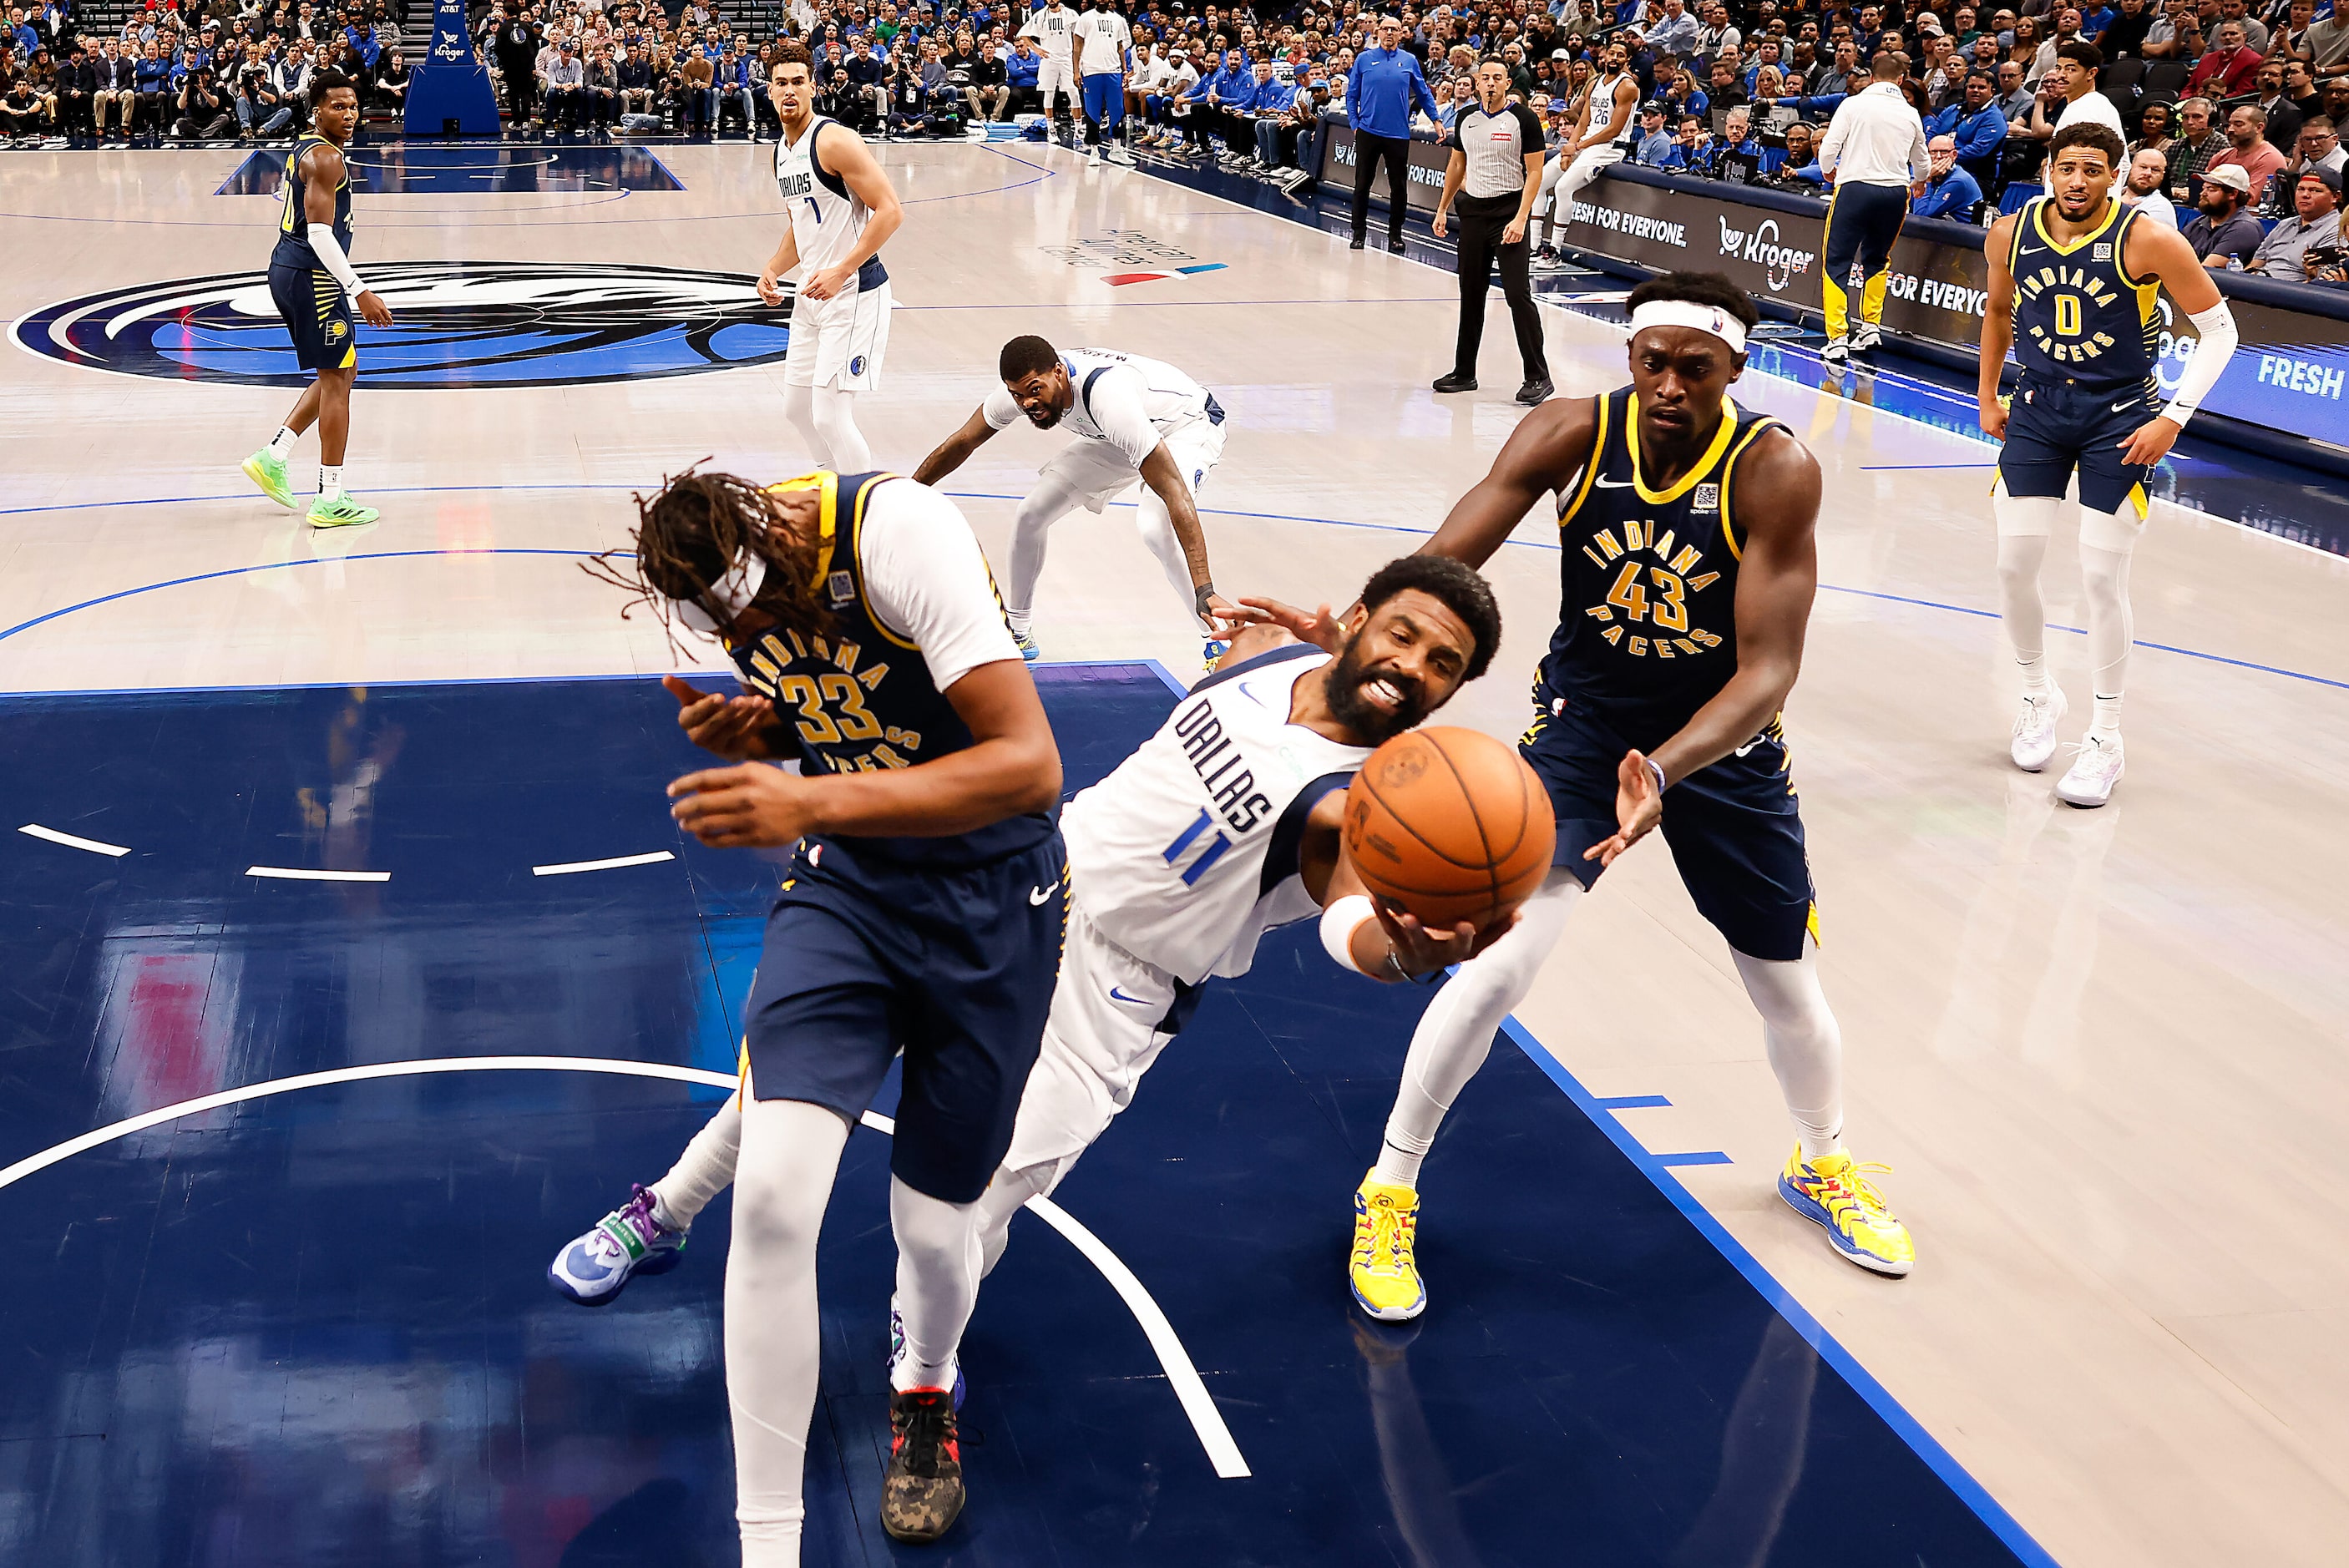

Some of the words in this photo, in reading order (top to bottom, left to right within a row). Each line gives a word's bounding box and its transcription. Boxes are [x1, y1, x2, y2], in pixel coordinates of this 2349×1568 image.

[440, 5, 460, 13] AT&T
[1097, 19, 1113, 33] VOTE
[435, 44, 465, 61] Kroger
[1590, 97, 1609, 108] DALLAS
[1594, 109, 1608, 125] 26
[779, 172, 812, 198] DALLAS
[1409, 164, 1425, 184] FOR
[1425, 168, 1445, 188] EVER
[804, 196, 822, 224] 7
[1596, 206, 1621, 231] FOR
[1099, 229, 1197, 260] American
[1744, 219, 1815, 291] Kroger
[1921, 278, 1988, 317] EVERYO
[2021, 265, 2118, 308] INDIANA
[2054, 294, 2082, 336] 0
[2029, 325, 2115, 362] PACERS
[2257, 355, 2345, 400] FRESH
[1582, 519, 1721, 592] INDIANA
[1606, 561, 1688, 632] 43
[1585, 604, 1723, 658] PACERS
[749, 628, 890, 698] INDIANA
[778, 673, 884, 743] 33
[1175, 698, 1273, 833] DALLAS
[1162, 806, 1232, 888] 11
